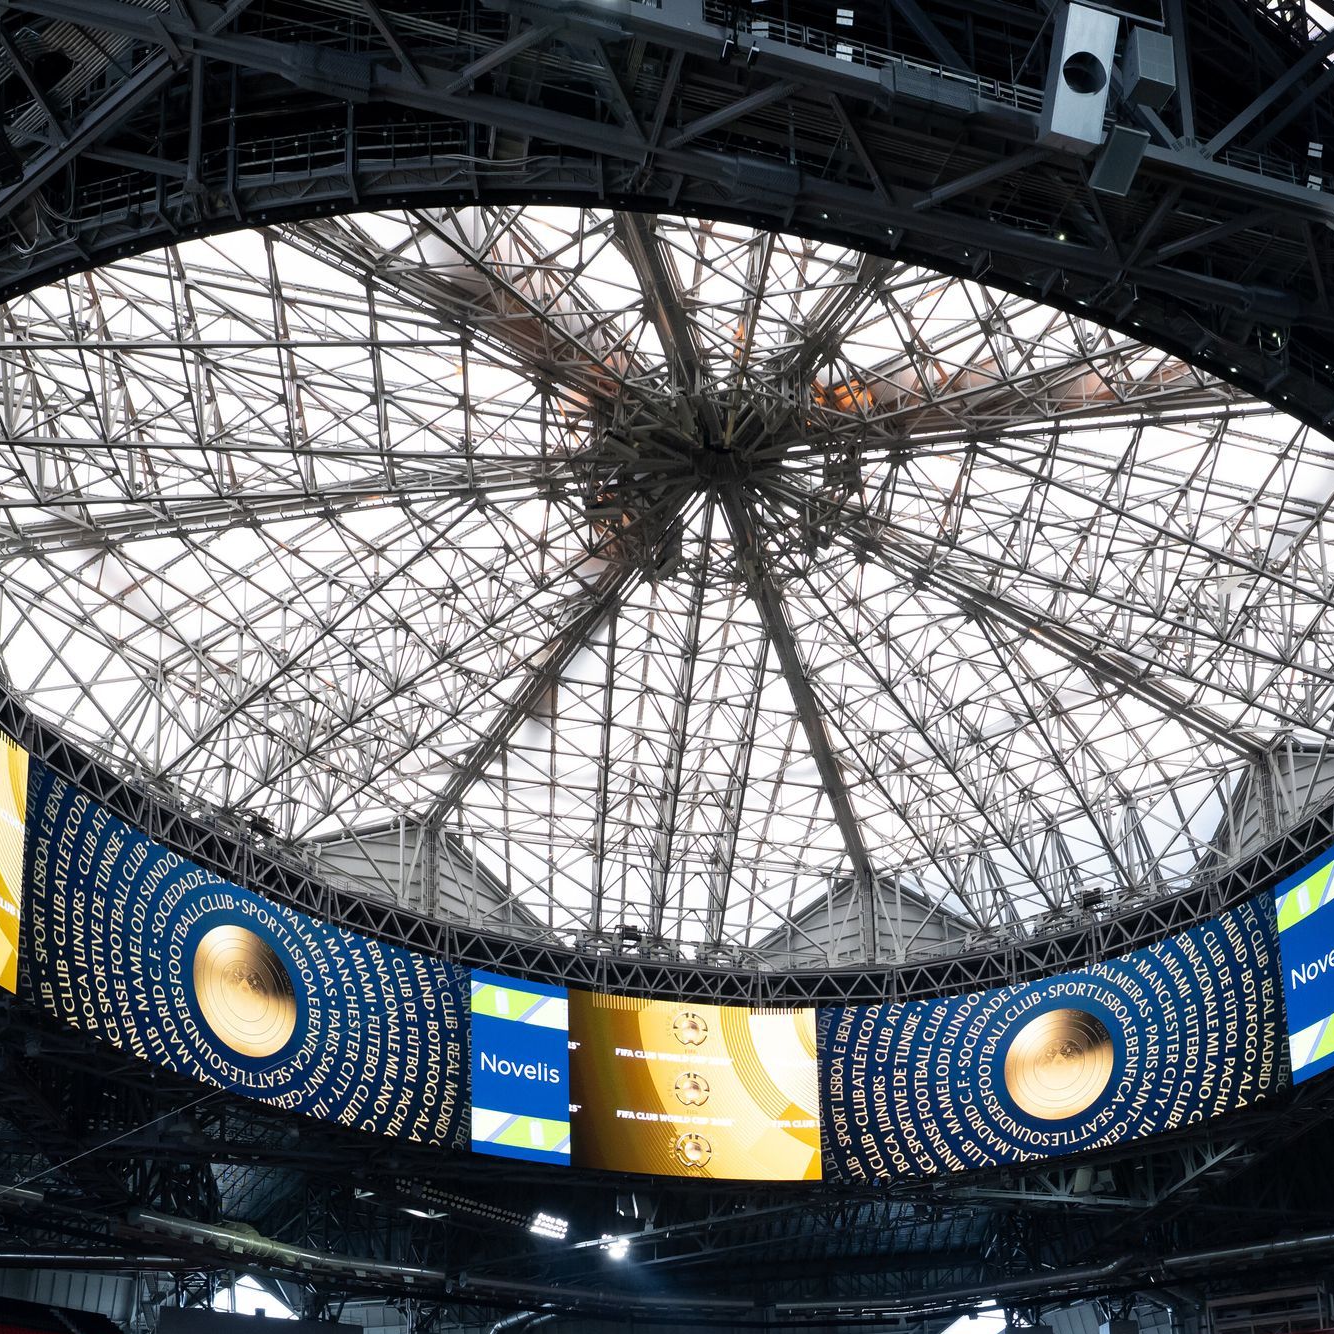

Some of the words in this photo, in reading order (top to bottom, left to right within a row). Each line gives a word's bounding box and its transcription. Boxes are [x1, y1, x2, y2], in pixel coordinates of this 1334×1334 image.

[78, 831, 97, 875] CLUB
[123, 841, 148, 881] CLUB
[152, 870, 206, 938] SOCIEDADE
[72, 888, 89, 969] JUNIORS
[1203, 931, 1222, 966] CLUB
[1250, 930, 1269, 968] CLUB
[130, 897, 150, 1011] MAMELODI
[1161, 955, 1191, 997] MIAMI
[325, 938, 360, 1061] MANCHESTER
[392, 958, 413, 998] CLUB
[1092, 963, 1152, 1017] PALMEIRAS
[1261, 978, 1275, 1019] REAL
[923, 1005, 947, 1042] CLUB
[959, 990, 1010, 1068] SOCIEDADE
[1136, 960, 1179, 1064] MANCHESTER
[1241, 969, 1257, 1063] BOTAFOGO
[423, 1020, 440, 1106] BOTAFOGO
[616, 1048, 633, 1058] FIFA
[875, 1027, 893, 1062] CLUB
[1145, 1023, 1159, 1069] PARIS
[1183, 1004, 1199, 1077] FUTEBOL
[1259, 1022, 1275, 1089] MADRID
[481, 1052, 560, 1083] Novelis
[830, 1056, 845, 1101] LISBOA
[894, 1068, 907, 1086] DE
[915, 1044, 932, 1119] FOOTBALL
[1115, 1036, 1139, 1102] BENFICA
[1155, 1068, 1176, 1109] CITY
[1199, 1033, 1218, 1099] MILANO
[873, 1076, 895, 1132] JUNIORS
[936, 1049, 963, 1135] MAMELODI
[616, 1110, 635, 1120] FIFA
[636, 1112, 658, 1122] CLUB
[831, 1105, 852, 1147] SPORT
[894, 1088, 923, 1154] SPORTIVE
[965, 1104, 1011, 1153] MADRID
[884, 1133, 910, 1174] BOCA
